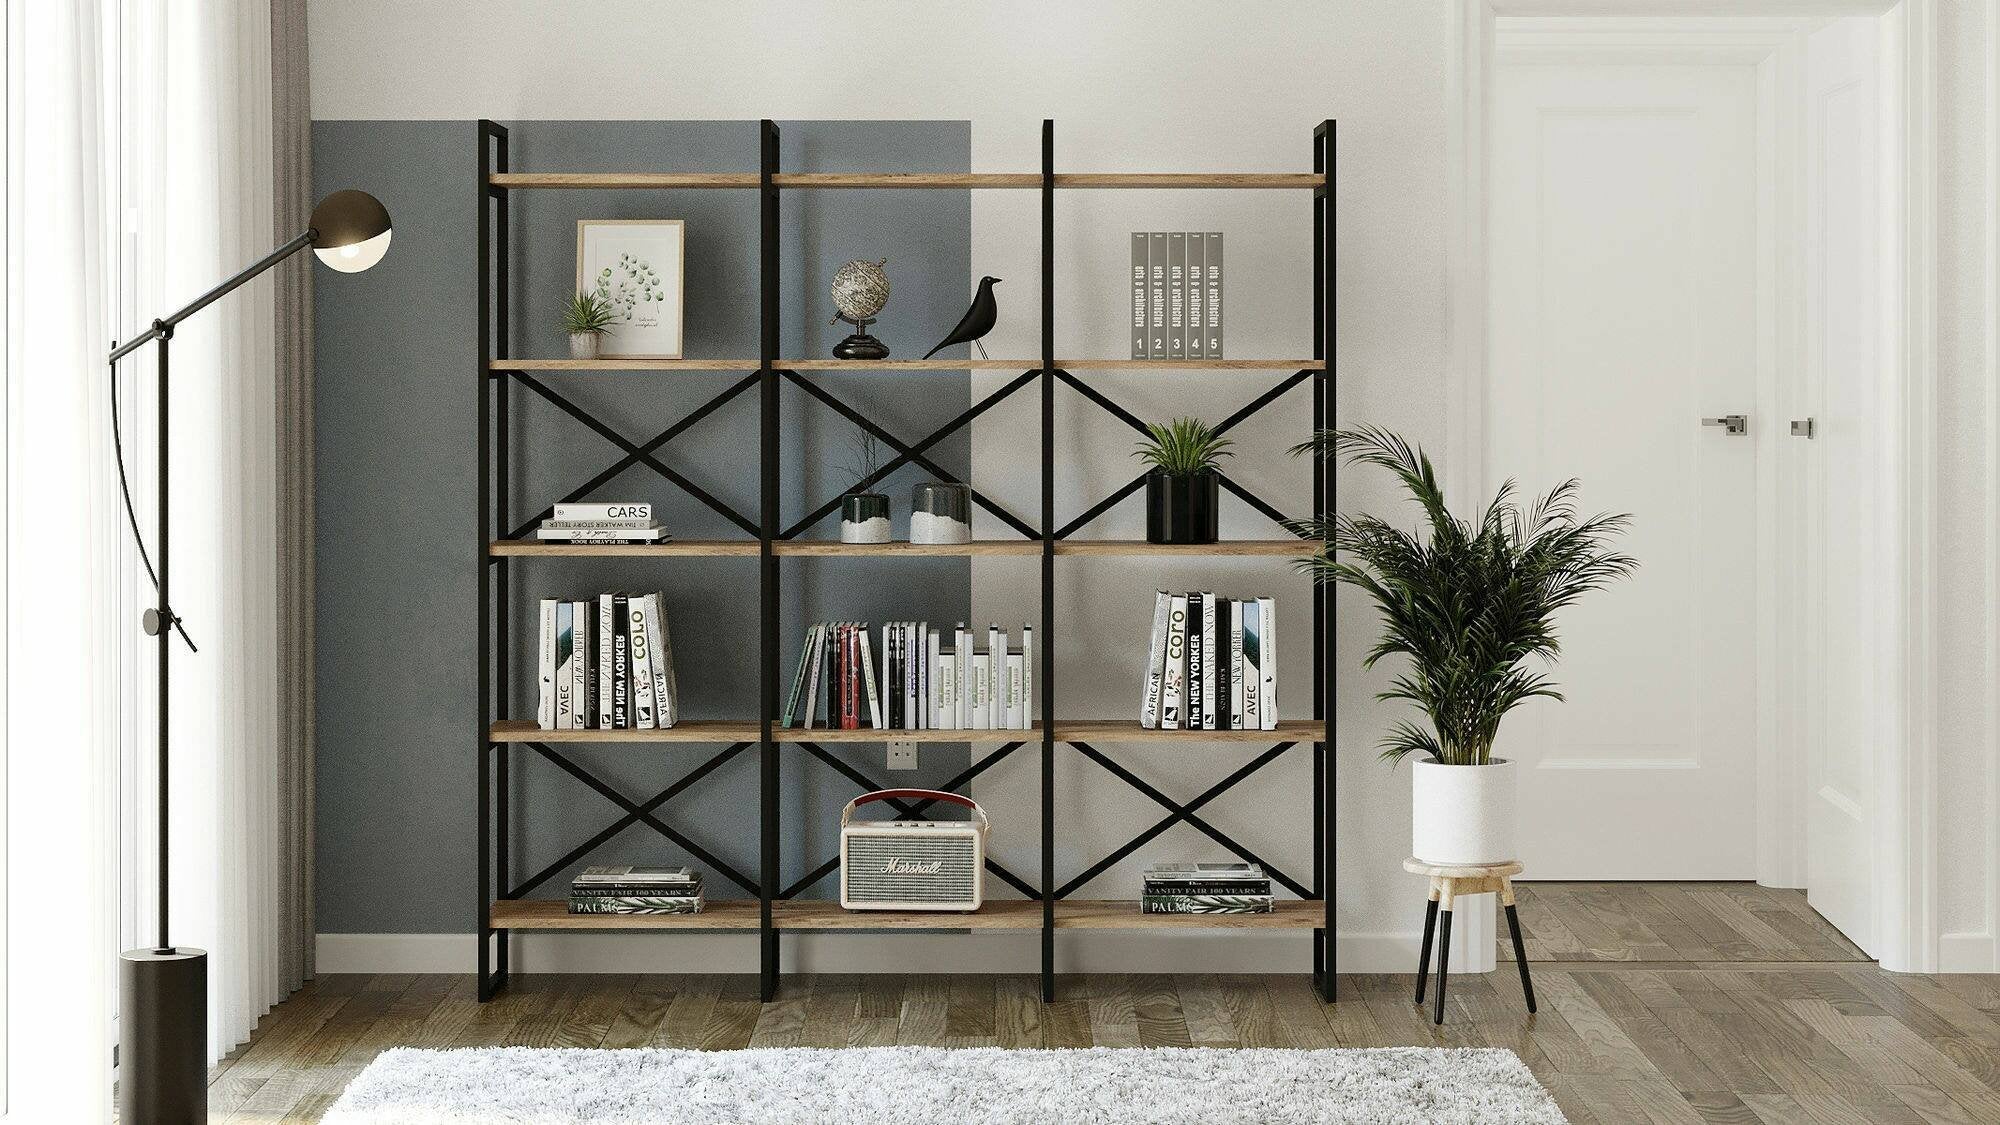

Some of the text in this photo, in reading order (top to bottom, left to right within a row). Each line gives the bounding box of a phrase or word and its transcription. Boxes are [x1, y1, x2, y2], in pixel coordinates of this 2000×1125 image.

[1137, 339, 1141, 349] 1
[1155, 339, 1161, 349] 2
[1174, 339, 1180, 349] 3
[1192, 339, 1199, 348] 4
[1211, 339, 1217, 349] 5
[608, 507, 647, 518] CARS
[1190, 635, 1199, 726] The NEW YORKER
[1148, 672, 1160, 716] AFRICAN
[1248, 686, 1256, 715] AVEC
[881, 857, 943, 874] Marshall
[578, 904, 619, 912] PALMS
[1152, 903, 1193, 912] PALMS
